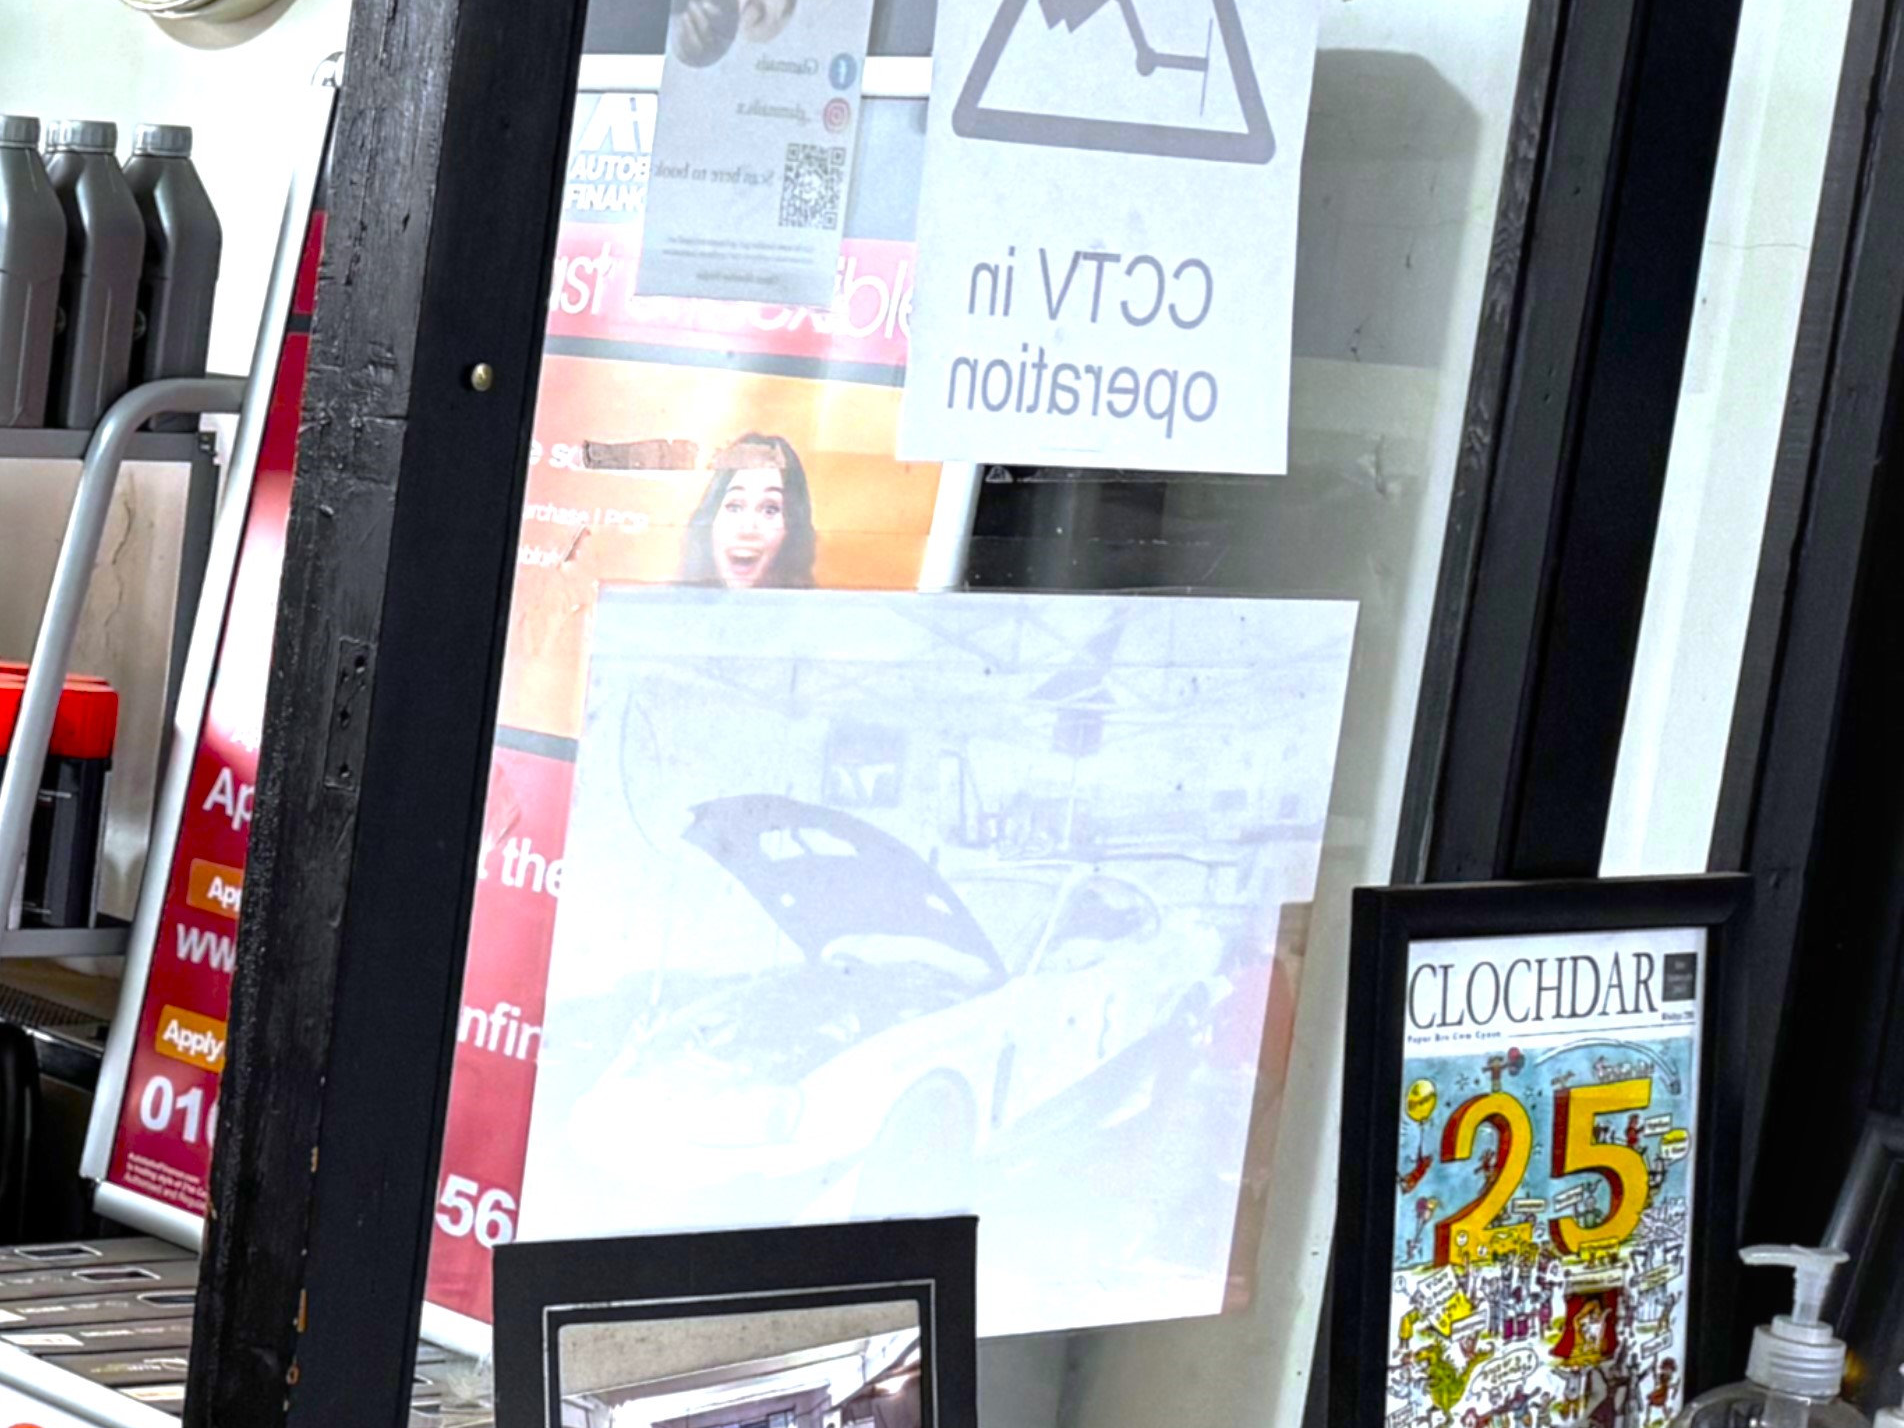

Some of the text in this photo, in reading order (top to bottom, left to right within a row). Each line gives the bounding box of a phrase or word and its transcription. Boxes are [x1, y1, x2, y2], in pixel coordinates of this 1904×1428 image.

[1408, 951, 1659, 1030] CLOCHDAR
[162, 1017, 225, 1061] Apply
[434, 1172, 518, 1248] 56
[1434, 1077, 1654, 1270] 25
